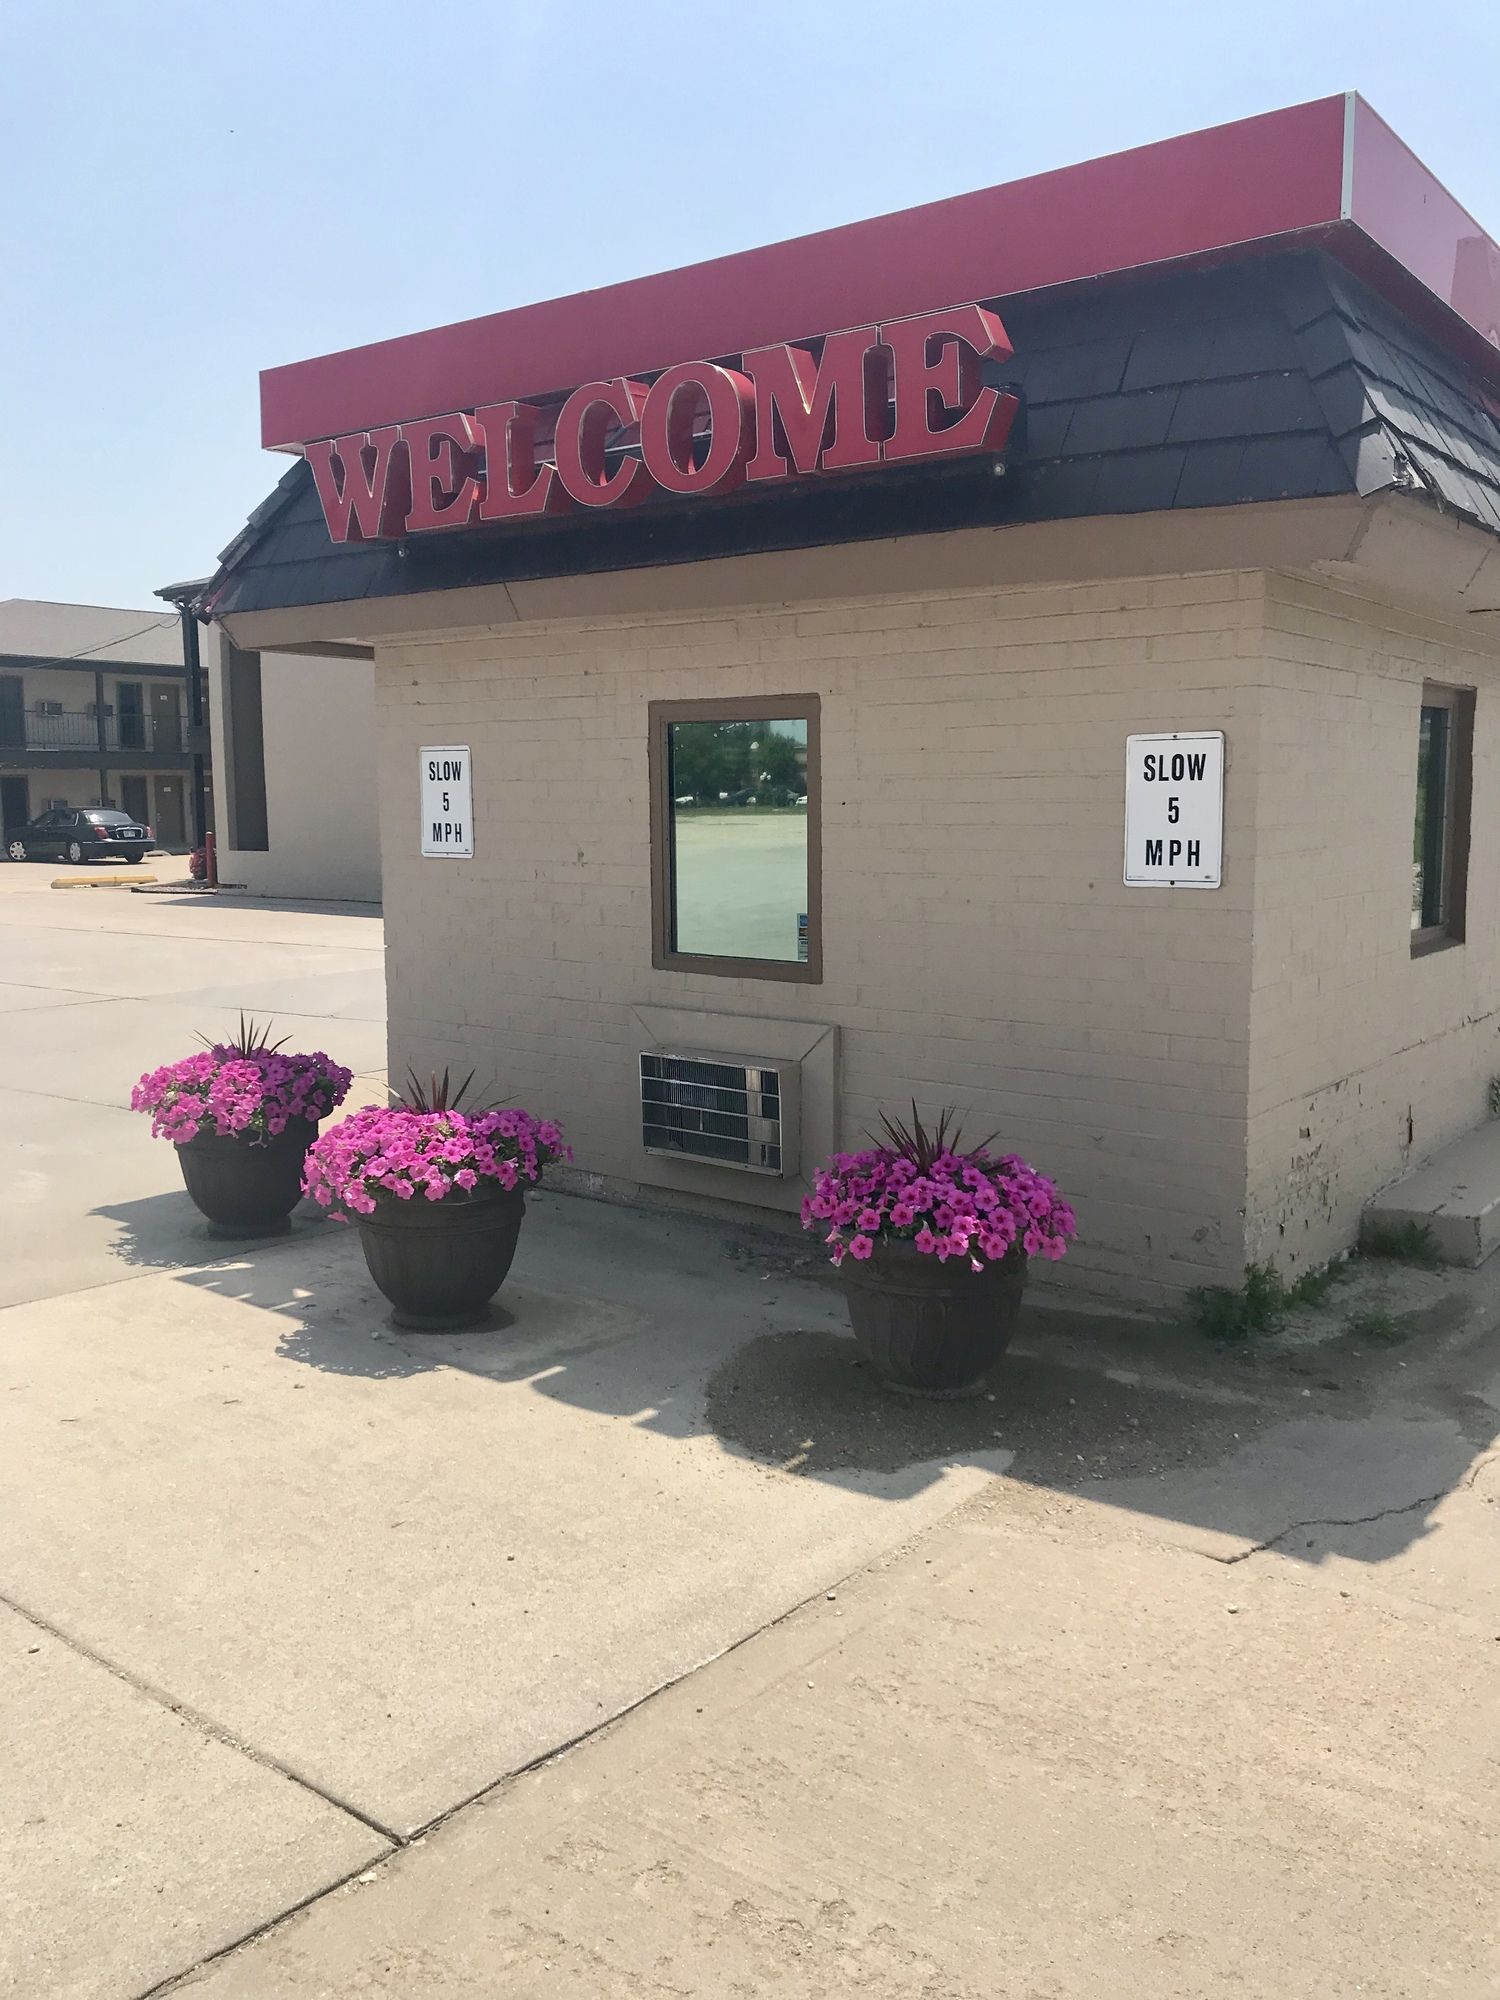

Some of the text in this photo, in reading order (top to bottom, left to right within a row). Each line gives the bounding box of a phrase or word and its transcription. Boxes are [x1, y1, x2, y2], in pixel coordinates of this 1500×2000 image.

[304, 305, 1016, 543] WELCOME
[429, 761, 461, 781] SLOW
[1143, 753, 1206, 782] SLOW
[442, 792, 449, 811] 5
[1168, 797, 1179, 823] 5
[432, 823, 462, 842] MPH
[1145, 840, 1200, 866] MPH
